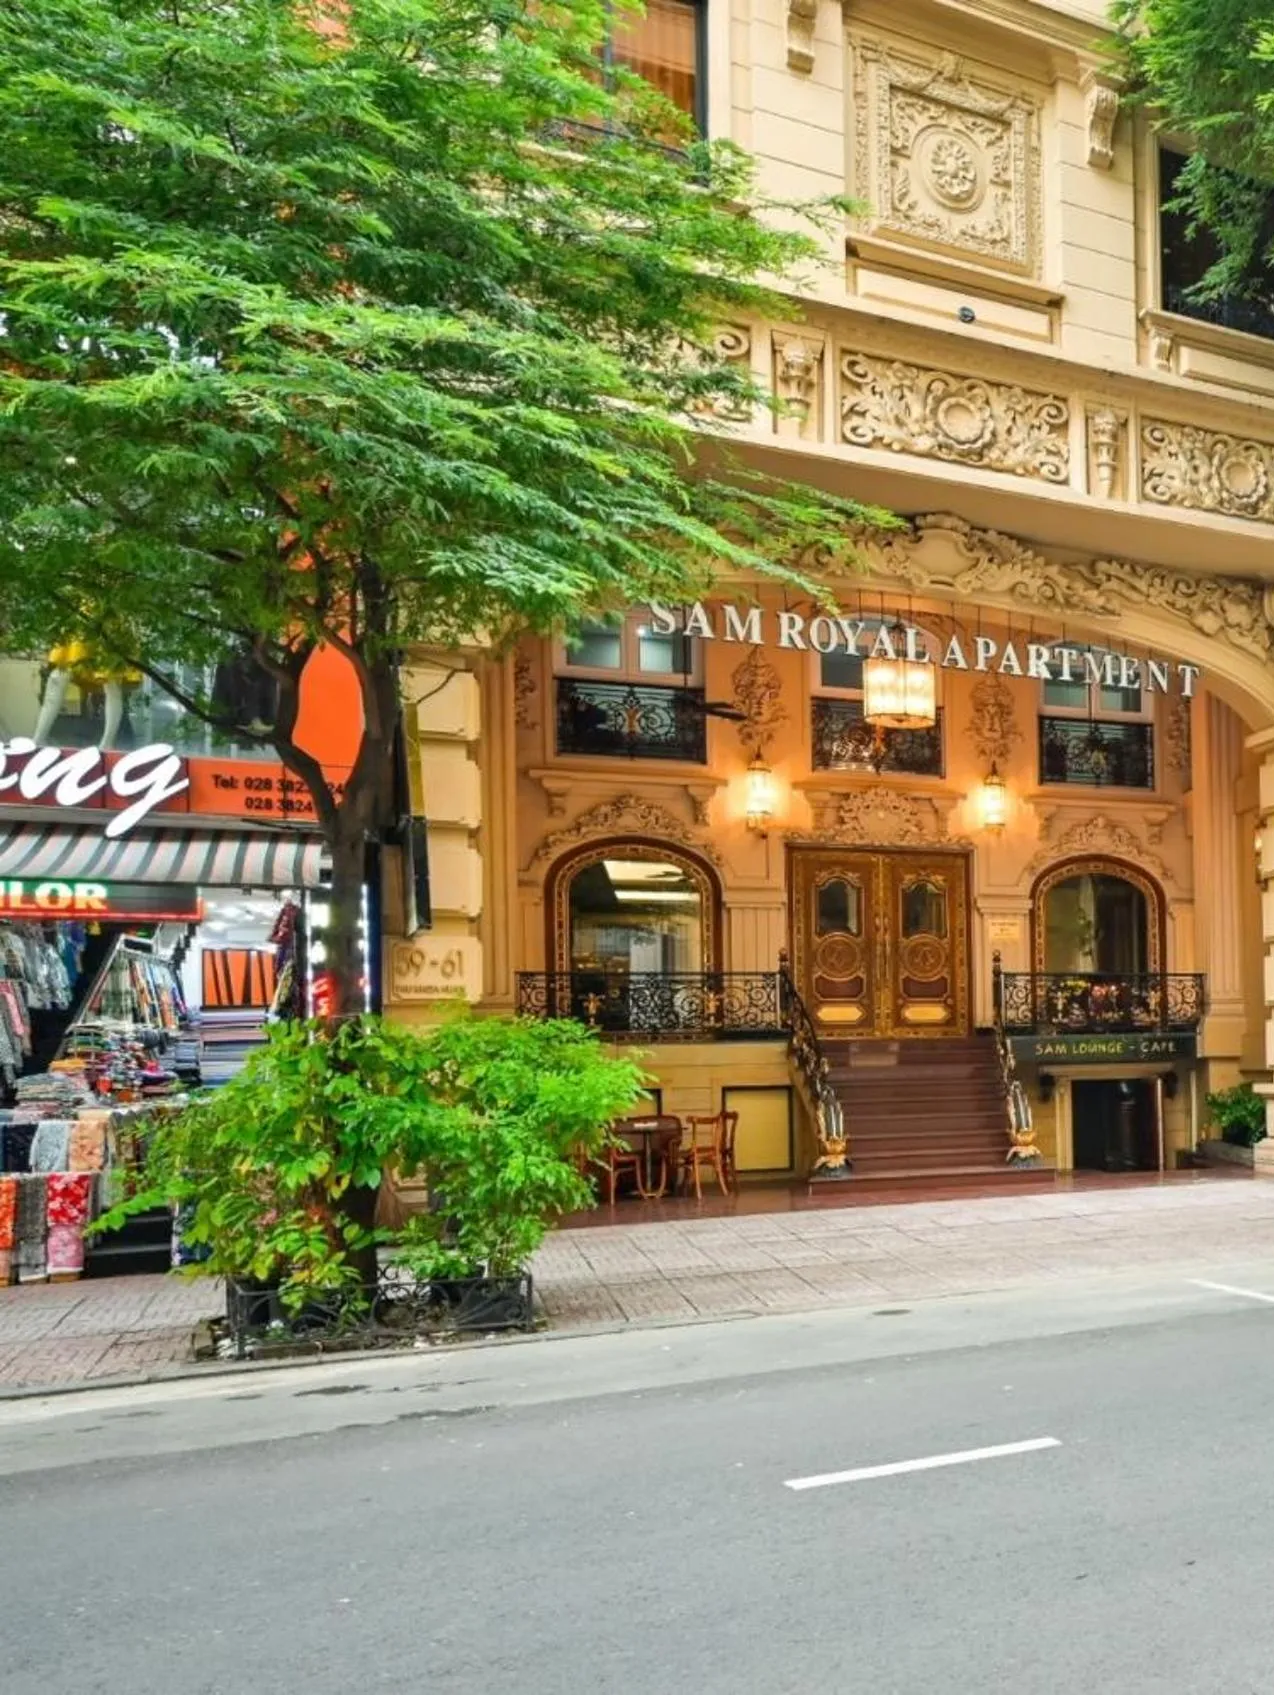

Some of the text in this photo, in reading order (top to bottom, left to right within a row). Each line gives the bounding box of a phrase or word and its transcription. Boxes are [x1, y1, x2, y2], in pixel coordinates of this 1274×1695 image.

[651, 601, 1199, 697] SAM ROYAL APARTMENT
[0, 881, 107, 910] LOR
[1034, 1042, 1068, 1056] SAM
[1072, 1041, 1124, 1055] LOUNGE
